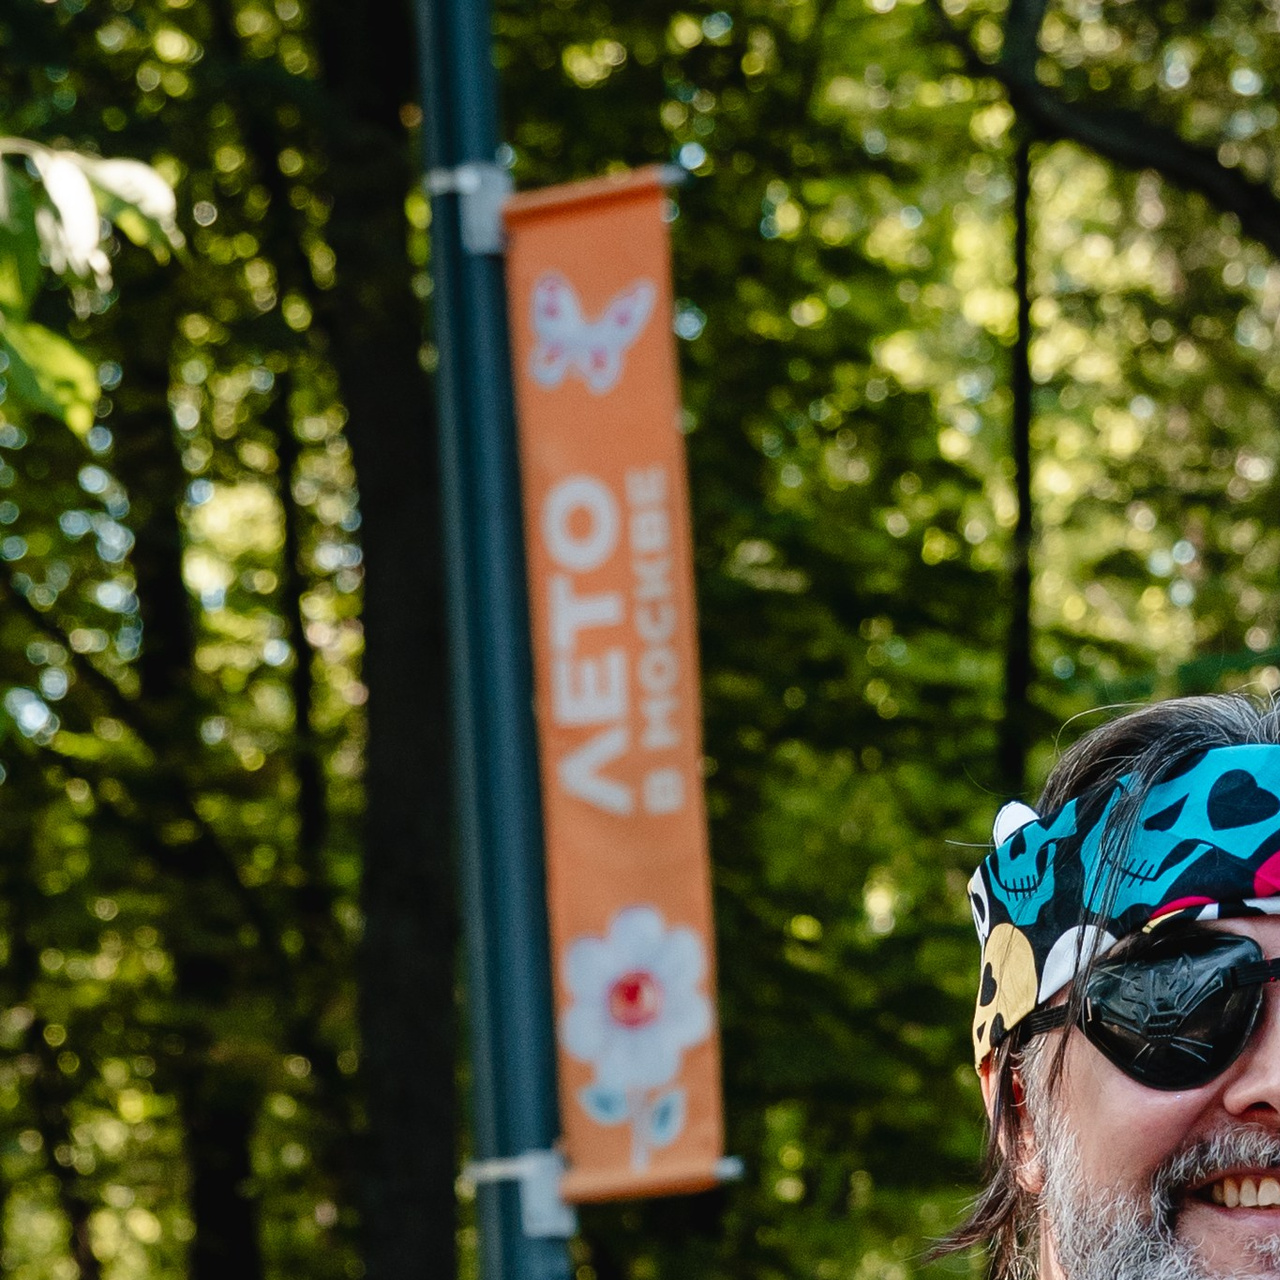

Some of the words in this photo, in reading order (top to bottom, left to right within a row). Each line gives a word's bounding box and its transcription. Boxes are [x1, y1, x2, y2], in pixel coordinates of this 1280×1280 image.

[541, 476, 633, 815] ЛЕТО
[625, 466, 682, 749] МОСКВЕ
[643, 767, 685, 814] В
